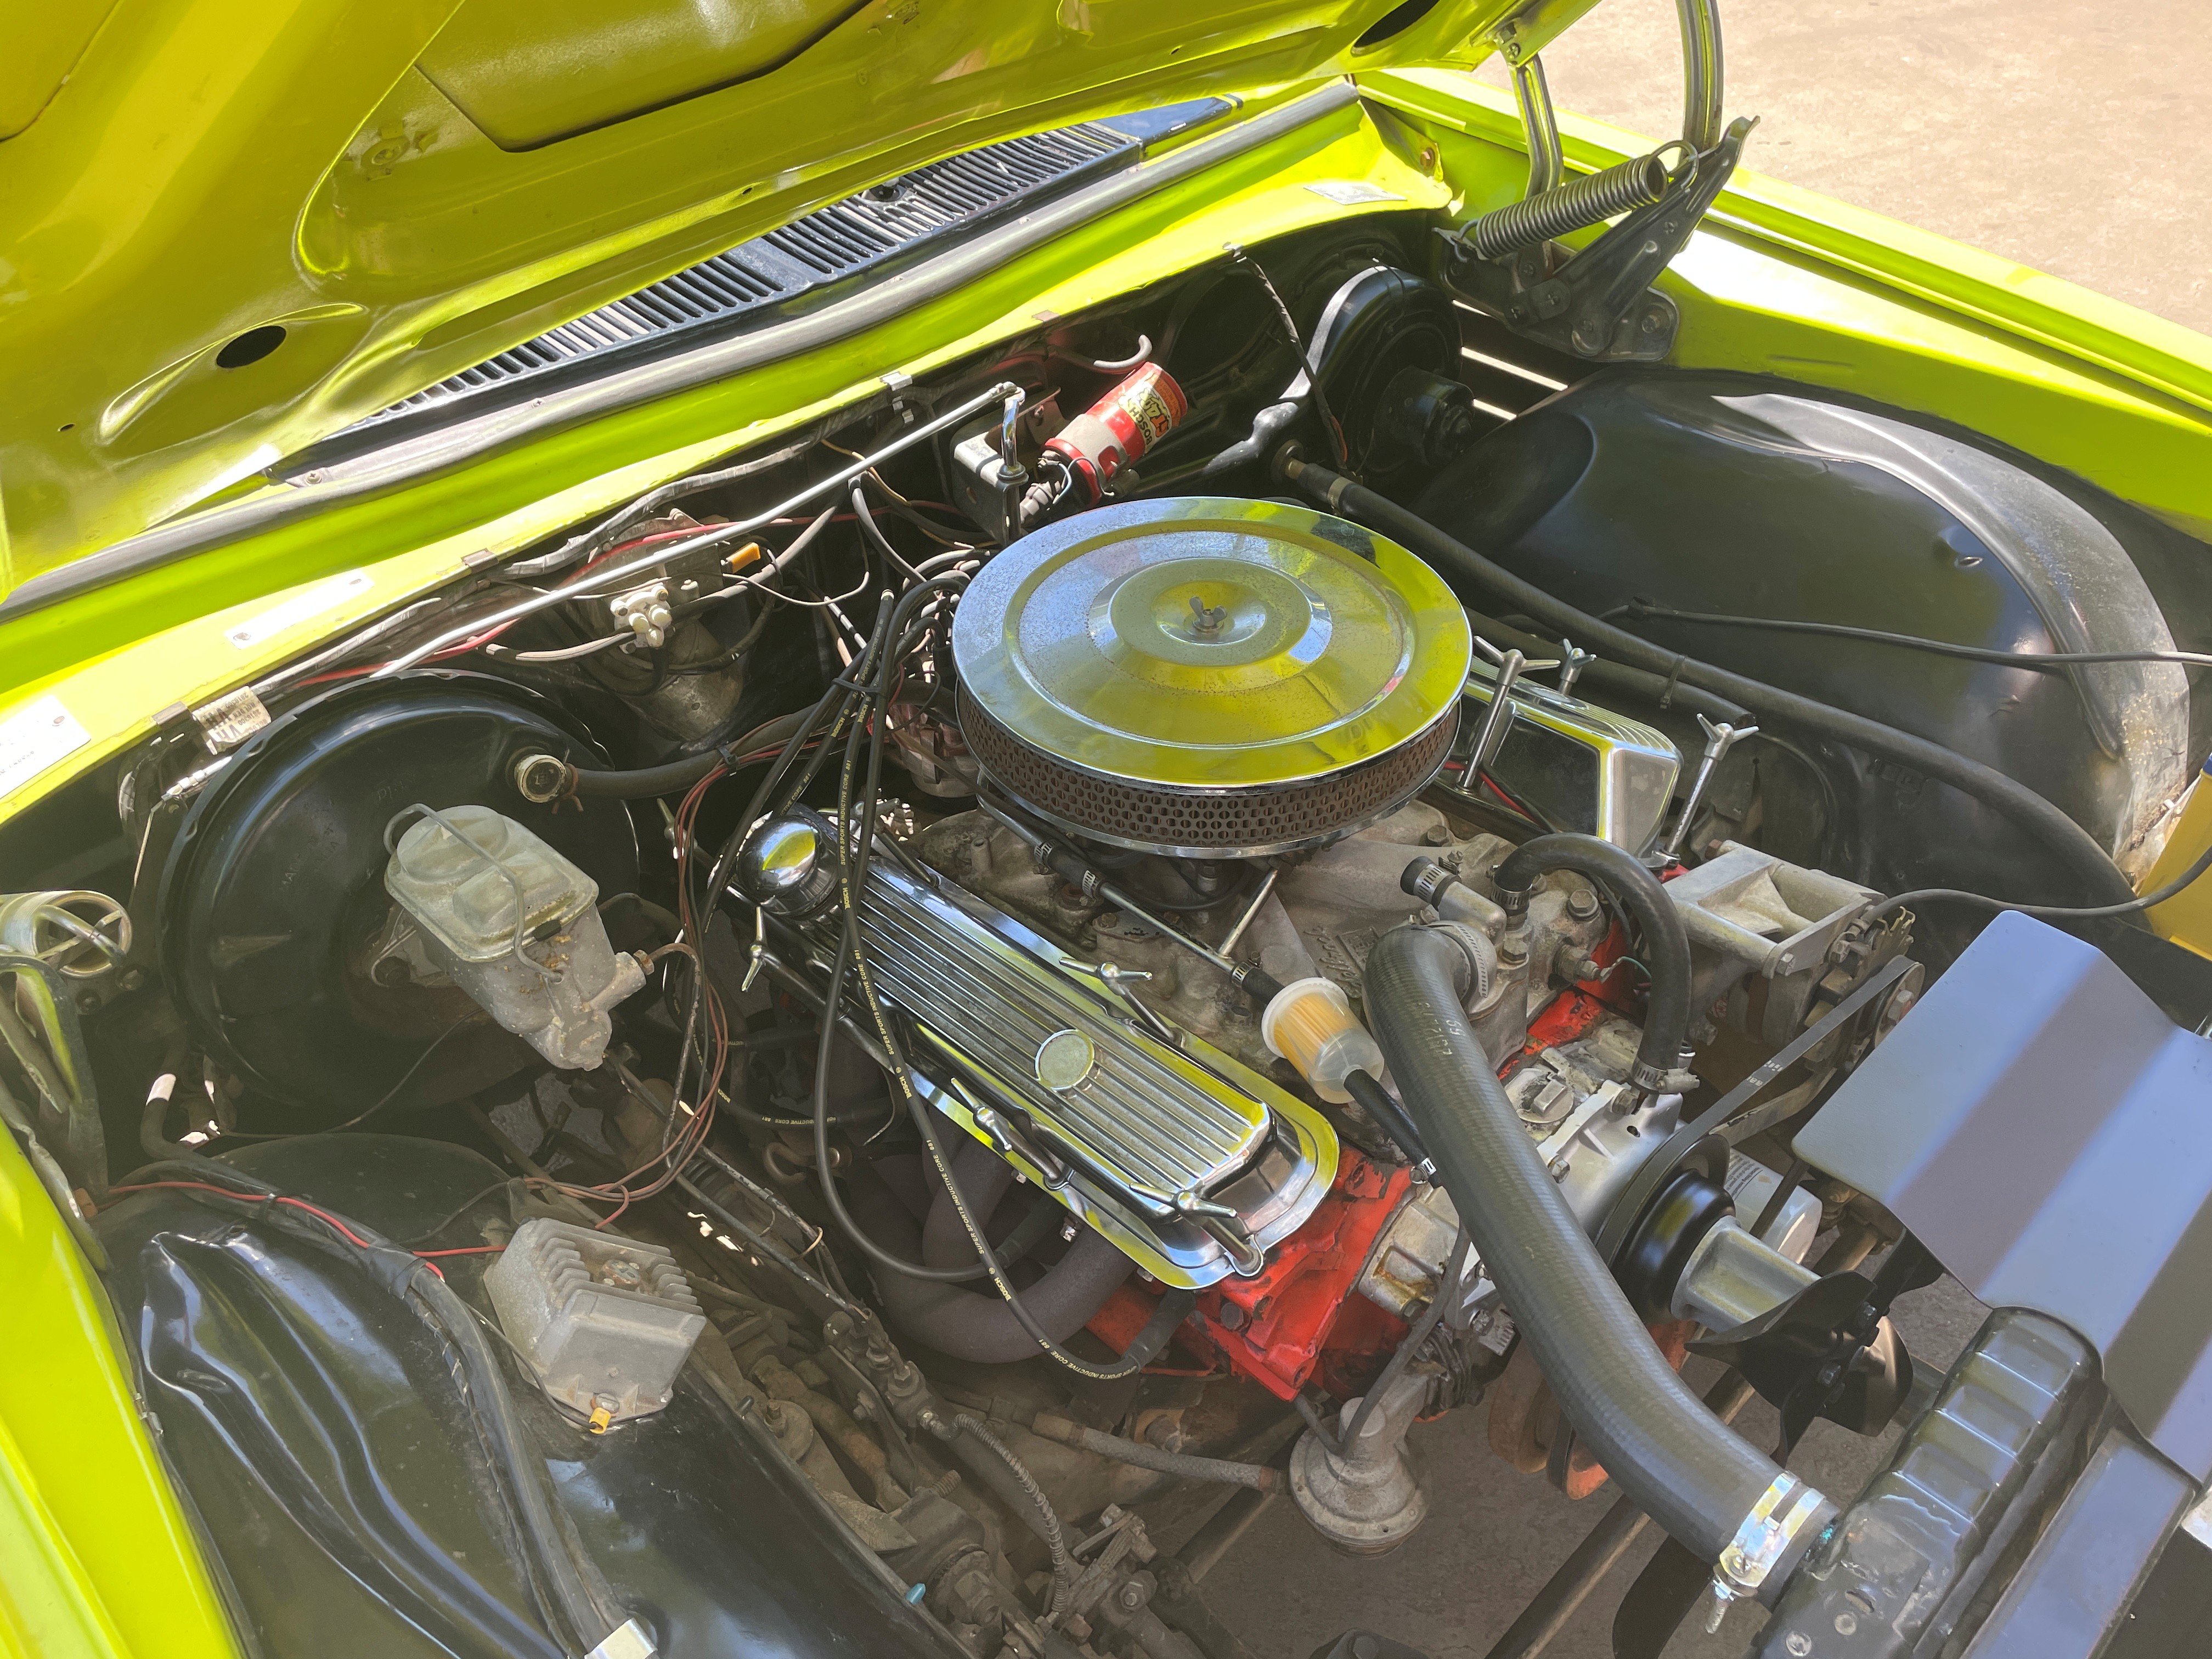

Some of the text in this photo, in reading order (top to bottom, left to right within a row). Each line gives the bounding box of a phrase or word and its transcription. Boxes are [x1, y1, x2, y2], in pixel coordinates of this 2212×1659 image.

[1129, 406, 1152, 445] BOSCH
[861, 660, 872, 680] SPORTS
[857, 704, 869, 723] BOSCH
[830, 717, 845, 738] BOSCH
[791, 785, 803, 801] CORE
[842, 887, 851, 911] BOSCH
[858, 963, 867, 980] CORE
[864, 980, 878, 1012] INDUCTIVE
[874, 1011, 887, 1035] SPORTS
[883, 1035, 894, 1055] SUPER
[899, 1075, 912, 1099] BOSCH
[926, 1139, 985, 1255] SUPER SPORTS INDUCTIVE CORE 881
[994, 1277, 1012, 1302] BOSCH
[1039, 1339, 1051, 1350] 881
[1050, 1350, 1068, 1365] CORE
[1067, 1362, 1099, 1379] INDUCTIVE
